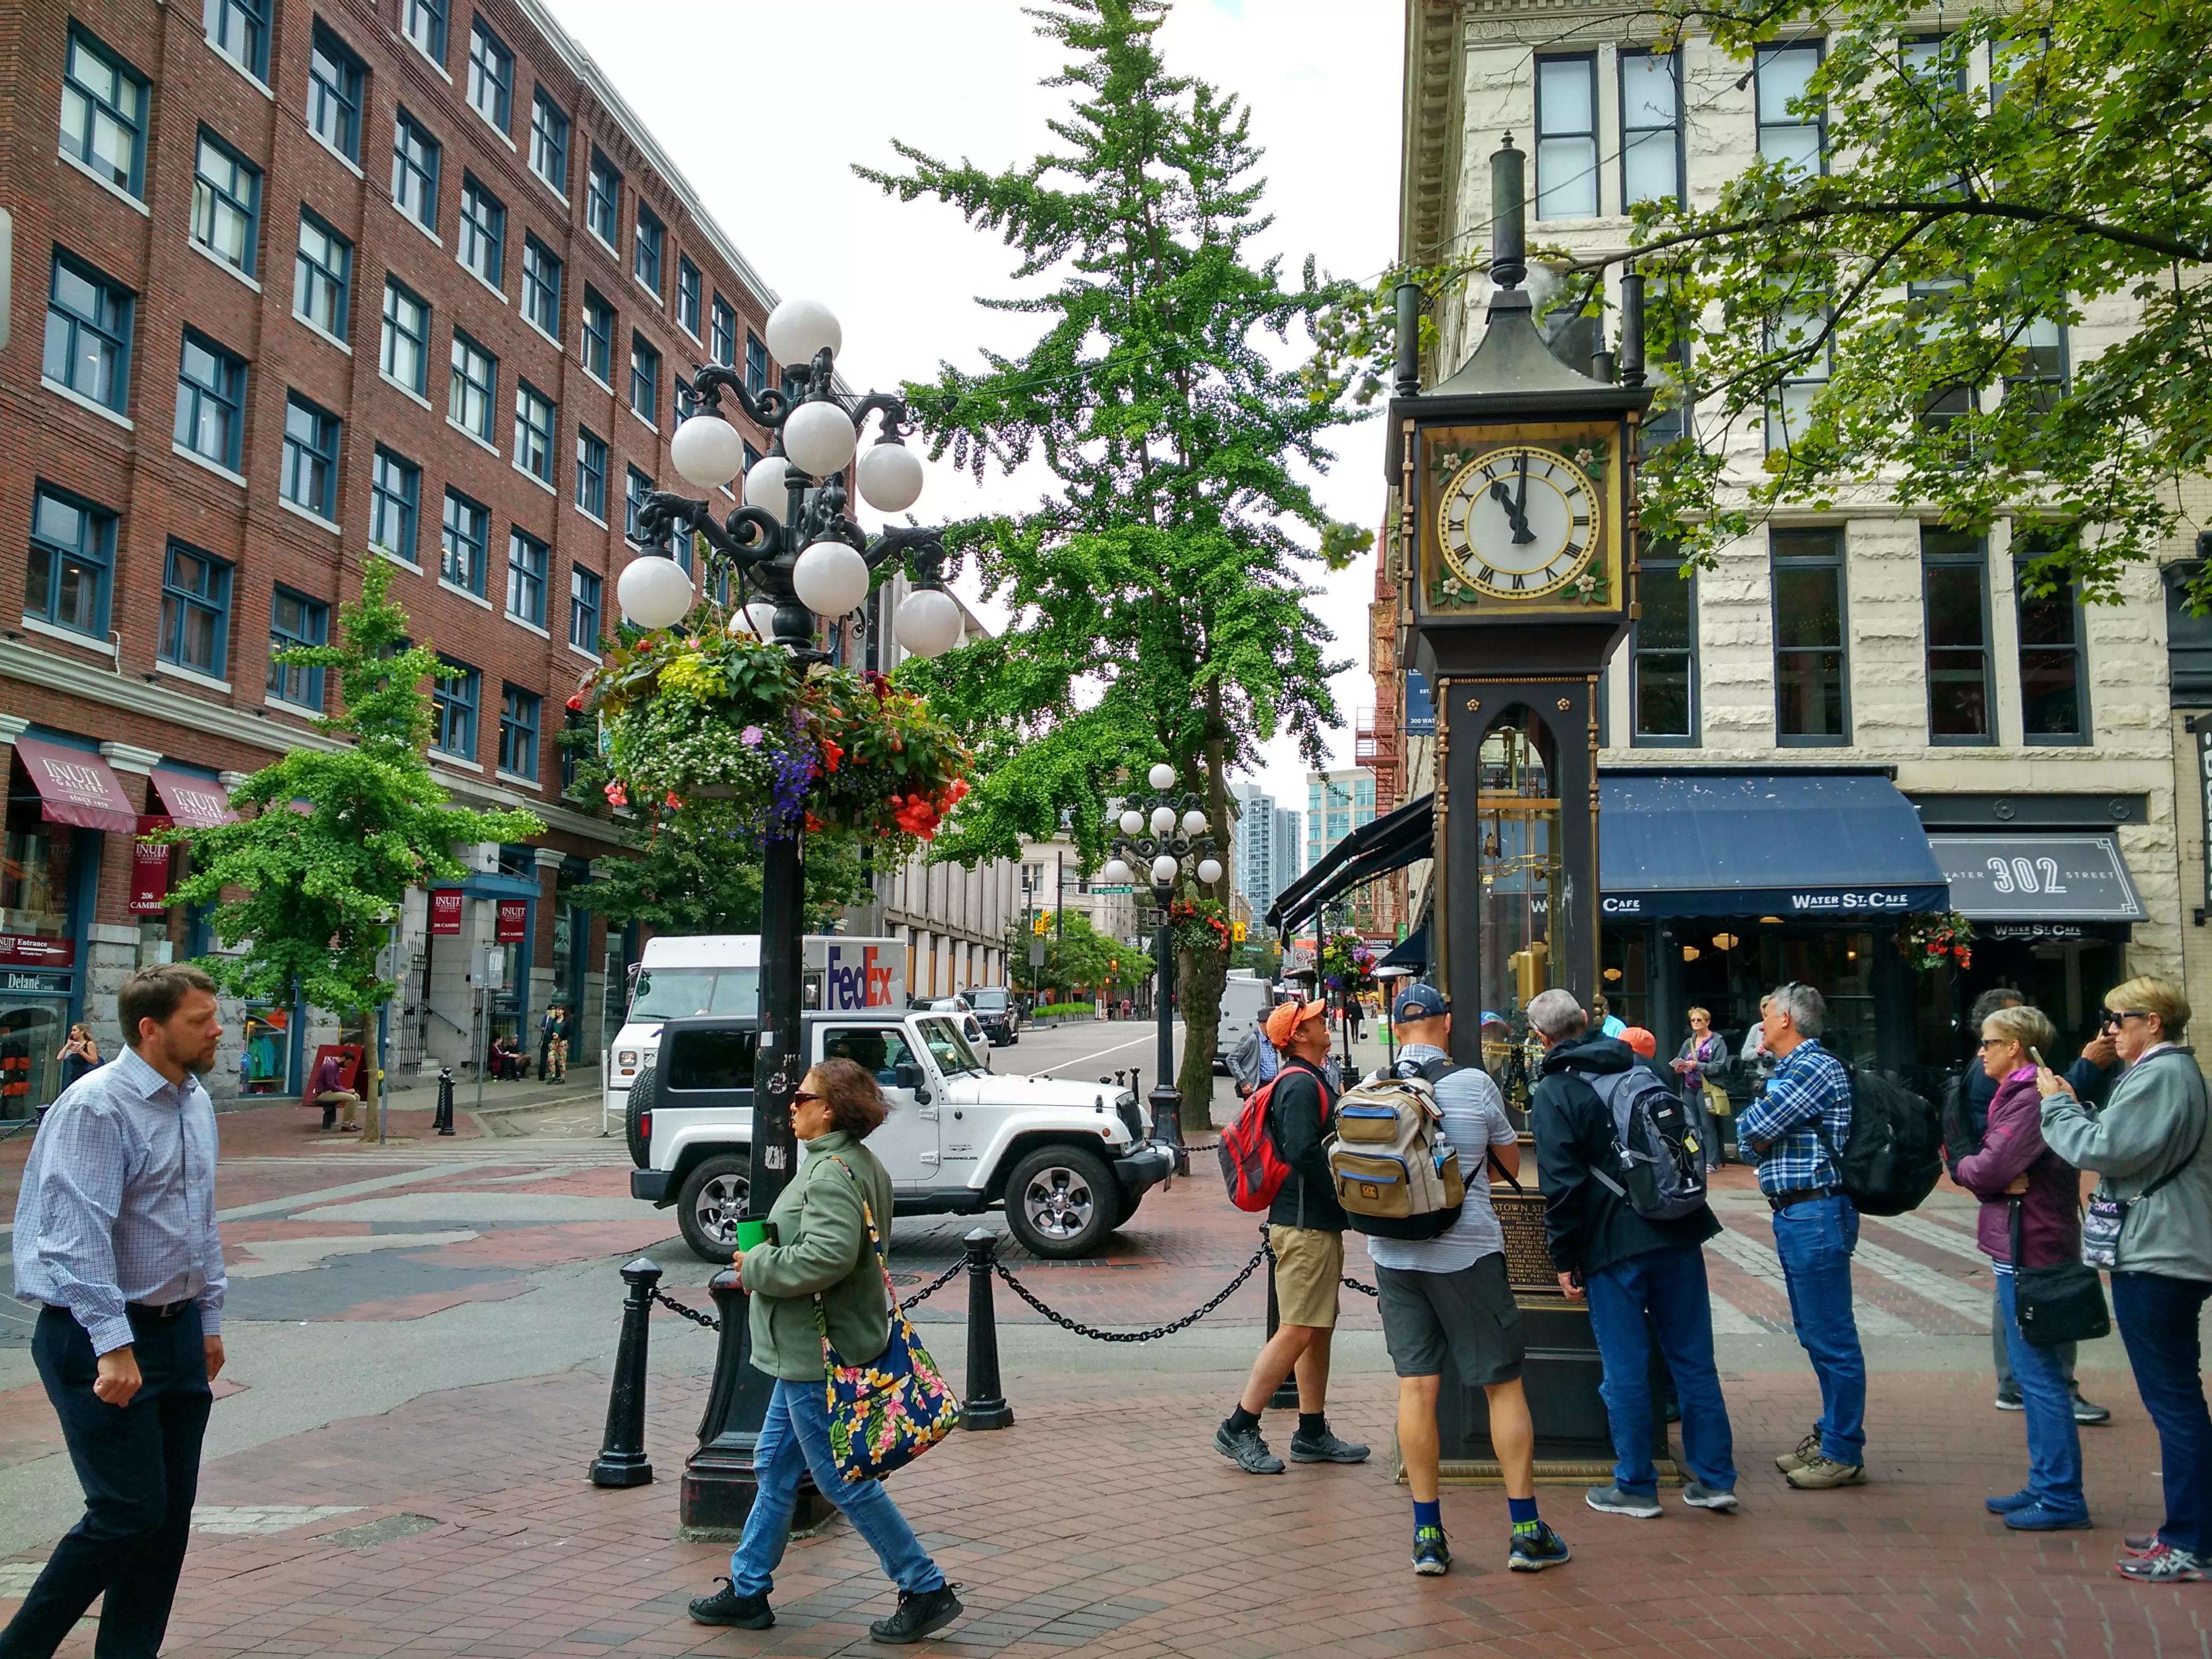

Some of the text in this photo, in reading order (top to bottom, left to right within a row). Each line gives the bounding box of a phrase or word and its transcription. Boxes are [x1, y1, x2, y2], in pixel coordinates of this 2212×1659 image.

[43, 759, 103, 787] INUIT
[56, 778, 104, 793] GALLERY
[171, 789, 222, 813] INUIT
[136, 844, 169, 854] INUIT
[1987, 857, 2067, 893] 302
[435, 896, 461, 904] INUIT
[1603, 898, 1640, 911] CAFE
[1792, 894, 1839, 909] WATER
[1869, 892, 1908, 907] CAFE
[1995, 925, 2030, 935] WATER
[2052, 924, 2081, 935] CAFE
[0, 937, 15, 946] NUIT
[18, 939, 48, 947] Entrance
[8, 973, 40, 989] Delané
[828, 946, 892, 1010] FedEx
[1493, 1203, 1528, 1212] STOWN
[2095, 1202, 2118, 1213] SKA
